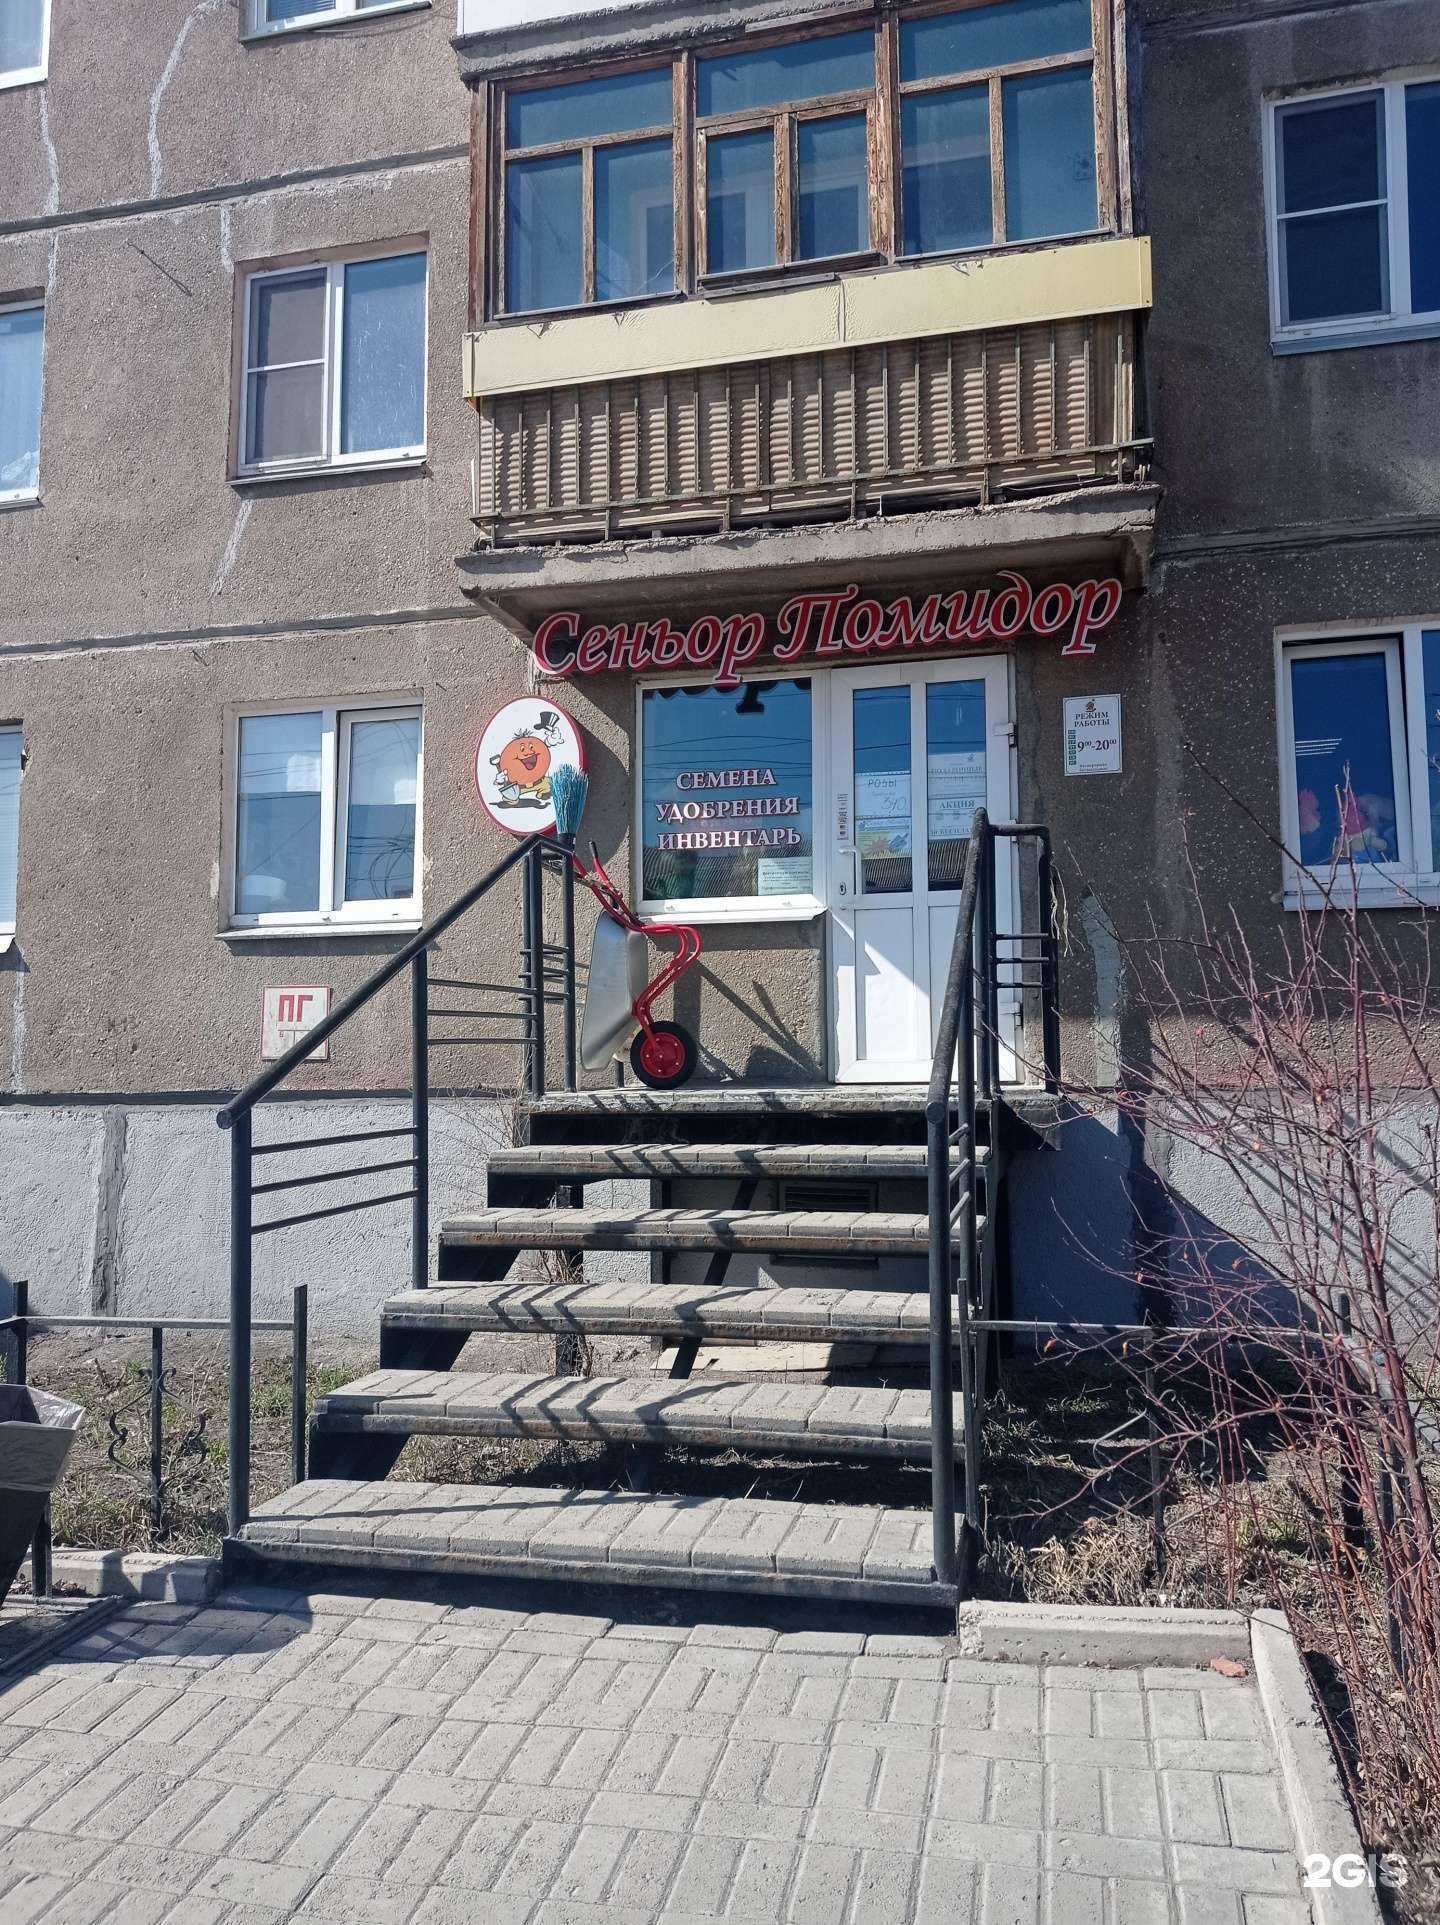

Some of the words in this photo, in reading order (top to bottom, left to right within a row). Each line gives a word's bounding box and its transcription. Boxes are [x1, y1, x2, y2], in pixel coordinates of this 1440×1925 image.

[533, 608, 765, 685] Сеньор
[773, 571, 1122, 658] Помидор
[1074, 719, 1110, 727] РАБОТЫ
[1075, 711, 1109, 720] РЕЖИМ
[676, 768, 777, 790] СЕМЕНА
[656, 797, 800, 824] УДОБРЕНИЯ
[939, 799, 975, 810] АКЦИЯ
[657, 827, 801, 851] ИНВЕНТАРЬ
[278, 994, 314, 1023] ПГ
